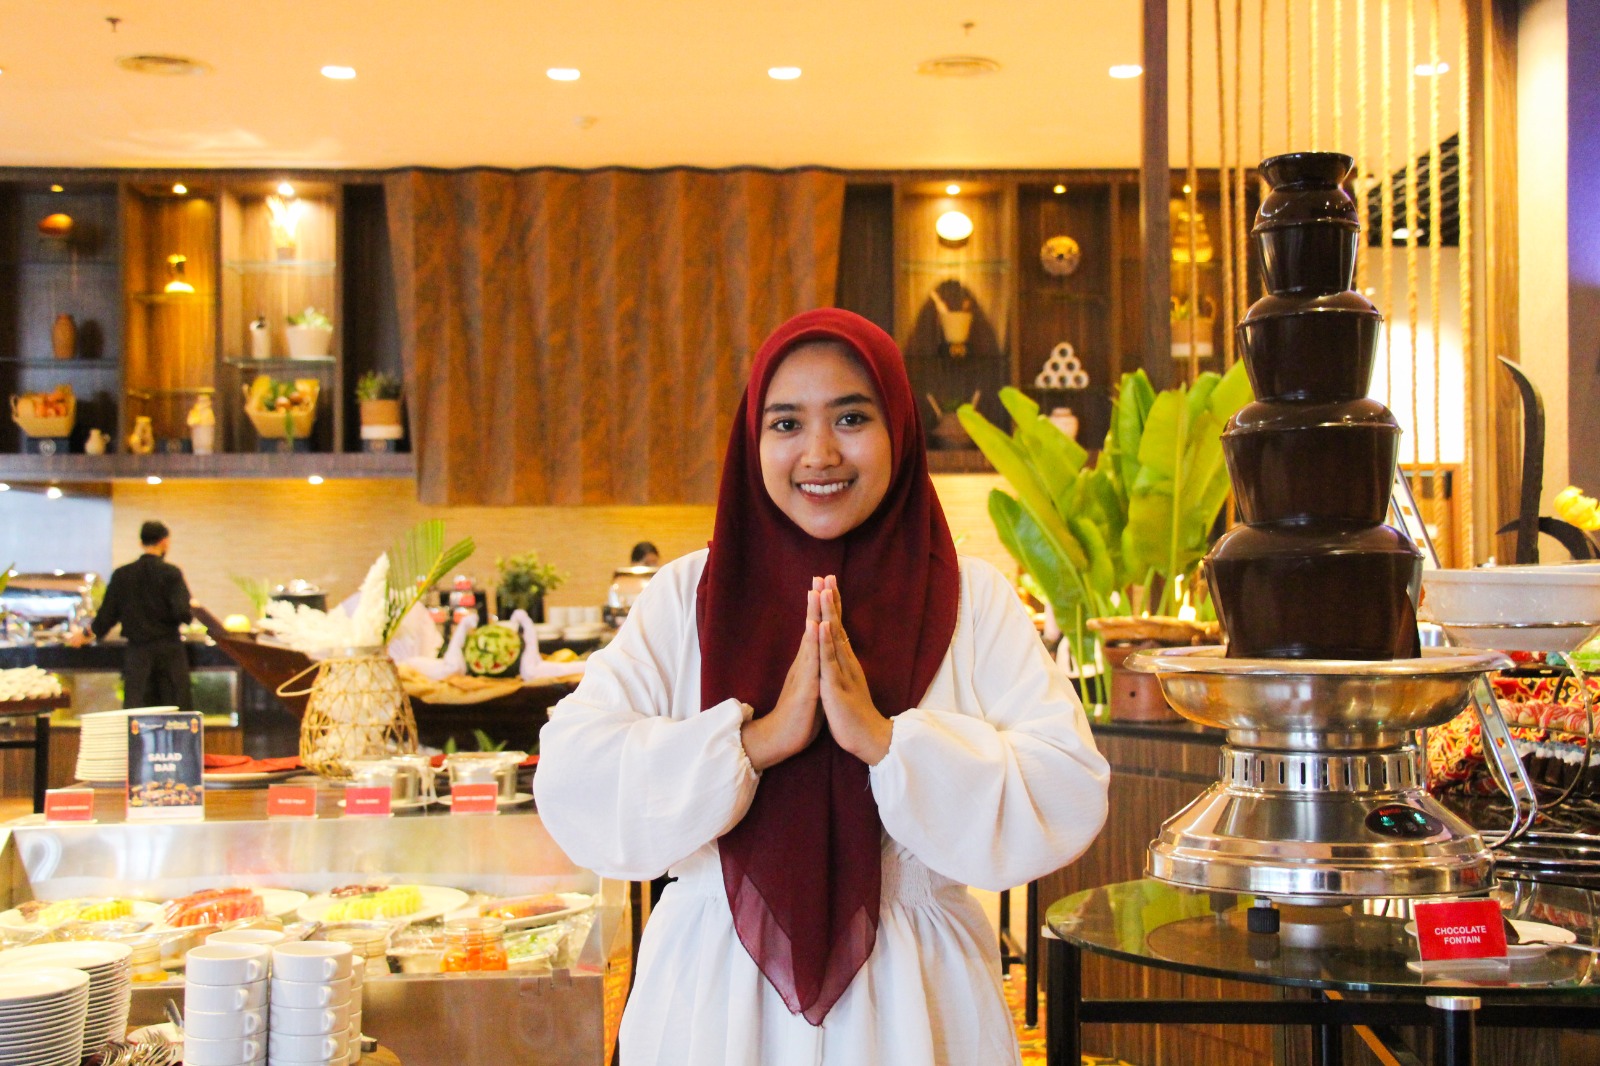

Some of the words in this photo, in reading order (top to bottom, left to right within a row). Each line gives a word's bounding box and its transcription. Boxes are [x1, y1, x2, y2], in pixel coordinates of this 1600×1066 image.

[148, 753, 182, 762] SALAD
[154, 764, 176, 772] BAR
[1435, 925, 1486, 935] CHOCOLATE
[1444, 936, 1481, 945] FONTAIN
